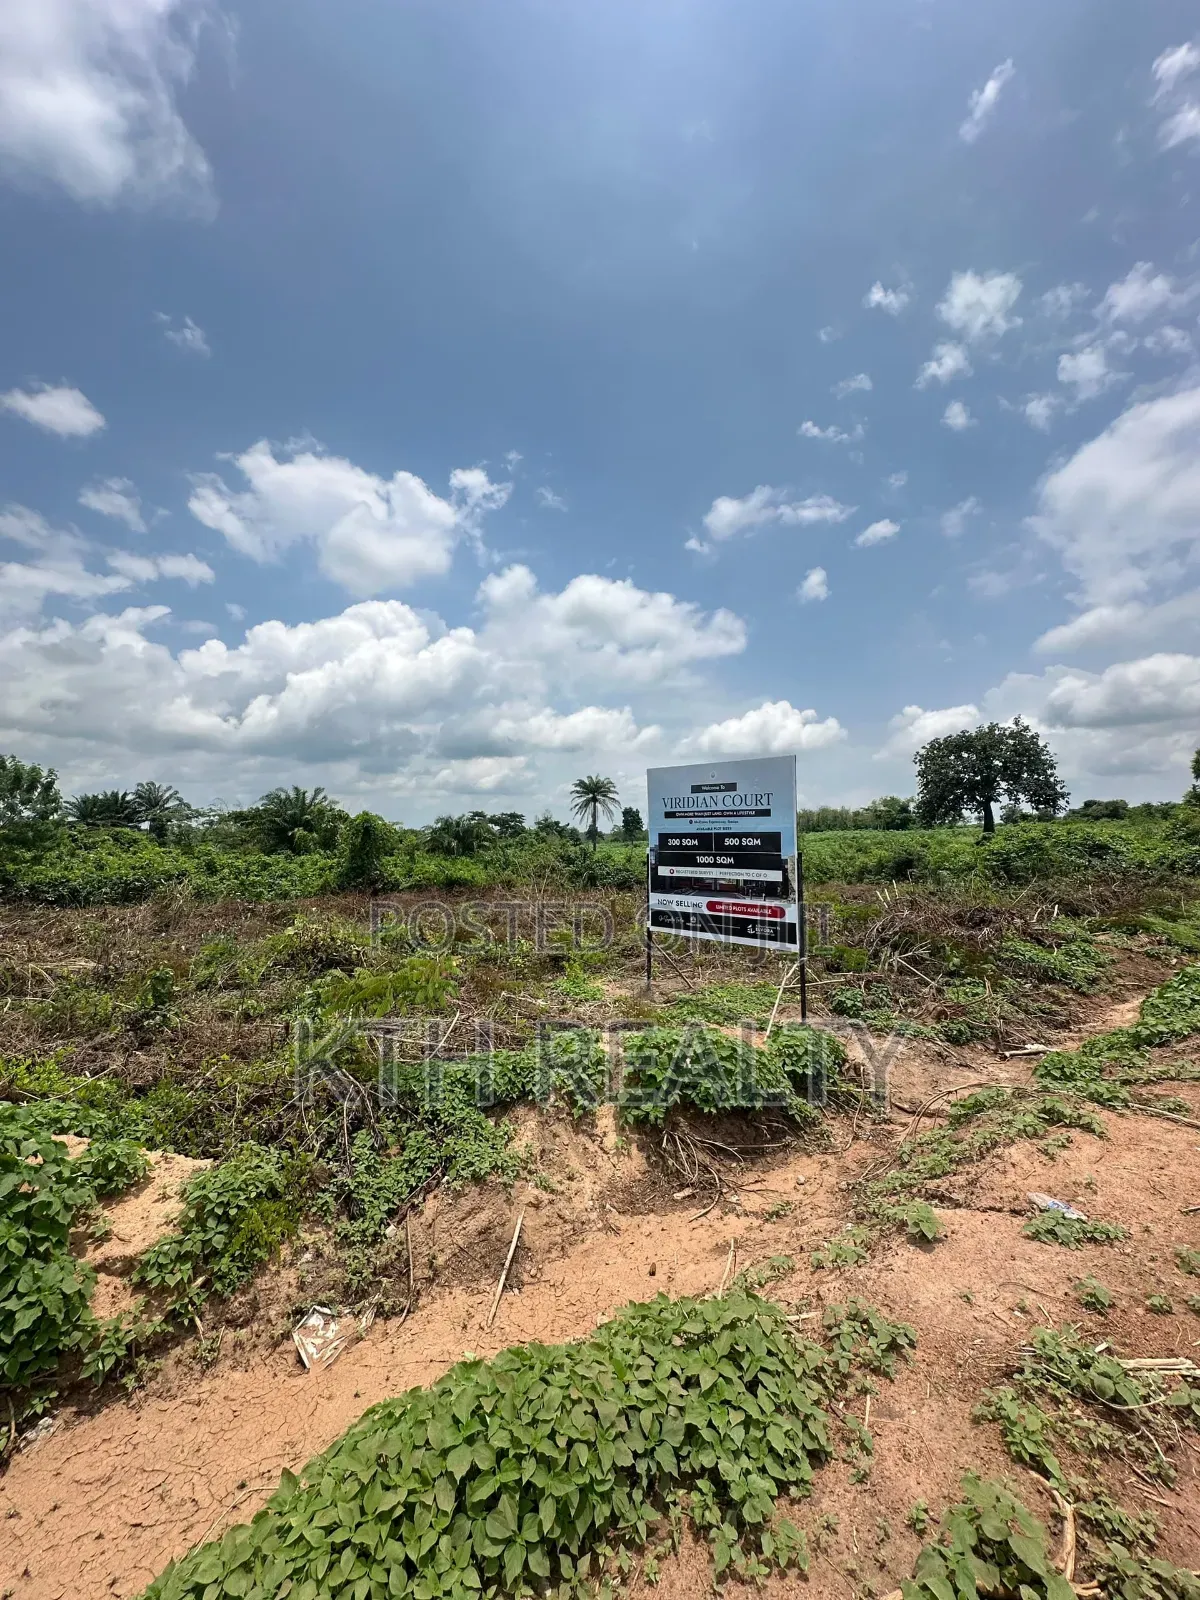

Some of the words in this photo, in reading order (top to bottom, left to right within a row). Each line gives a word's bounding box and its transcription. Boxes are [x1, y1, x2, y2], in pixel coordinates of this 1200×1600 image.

[662, 795, 718, 809] VIRIDIAN
[722, 792, 774, 808] COURT
[742, 838, 761, 846] SQM
